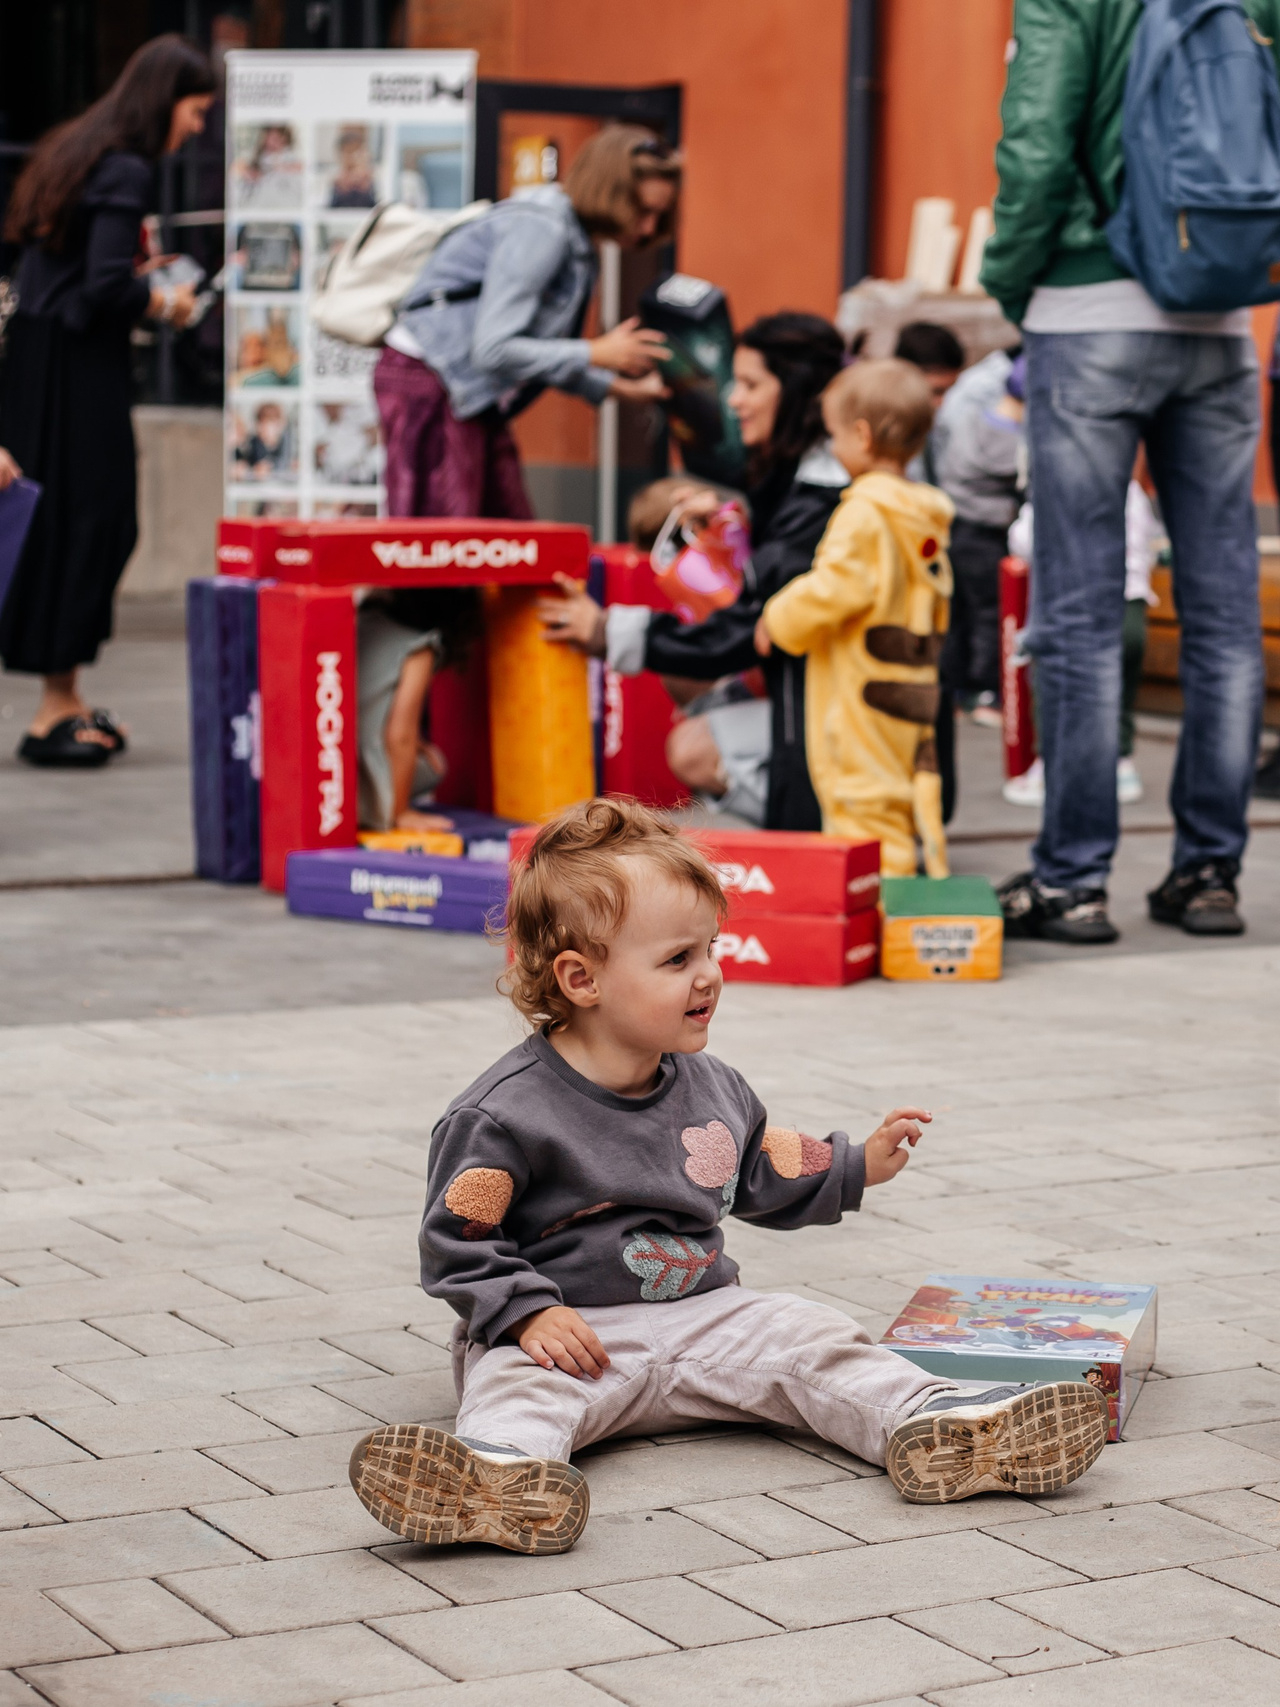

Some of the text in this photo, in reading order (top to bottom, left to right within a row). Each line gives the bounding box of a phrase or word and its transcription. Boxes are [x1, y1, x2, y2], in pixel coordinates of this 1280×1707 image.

[370, 538, 538, 569] МОСИГРА
[315, 650, 345, 837] МОСИГРА
[712, 932, 771, 965] РА
